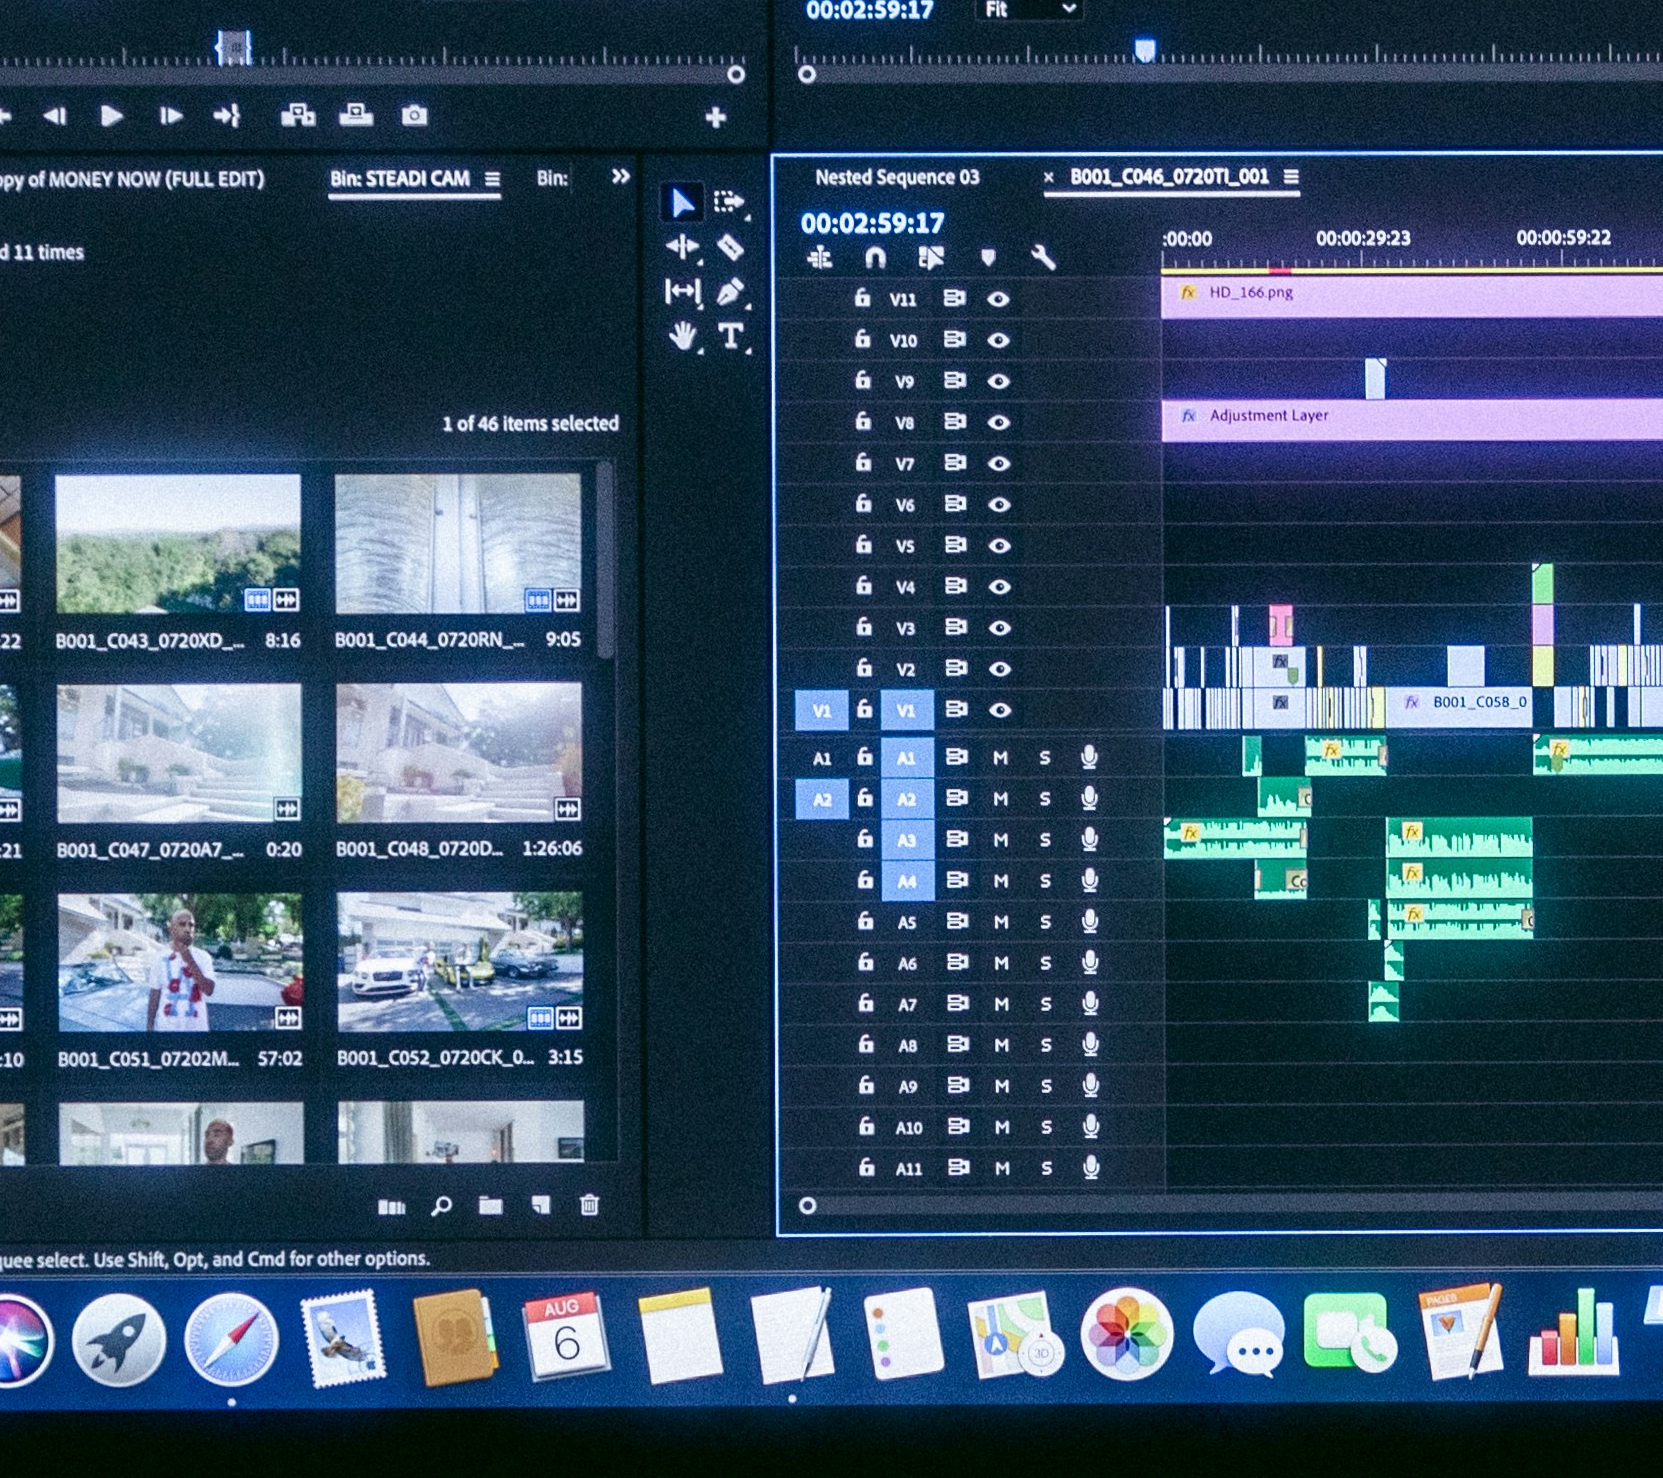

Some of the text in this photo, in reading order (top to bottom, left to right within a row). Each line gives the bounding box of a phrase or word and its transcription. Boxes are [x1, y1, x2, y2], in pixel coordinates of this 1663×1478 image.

[806, 0, 934, 20] 00:02:59:17
[986, 0, 1008, 18] Fit
[27, 170, 46, 188] of
[48, 170, 114, 188] MONEY
[117, 170, 162, 188] NOW
[164, 169, 215, 191] (FULL
[218, 169, 265, 190] EDIT)
[330, 169, 471, 188] Bin: STEADI CAM
[815, 167, 981, 189] Nested Sequence 03
[801, 212, 945, 234] 00:02:59:17
[1316, 229, 1412, 247] 00:00:29:23
[14, 244, 34, 261] 11
[37, 243, 85, 261] times
[889, 292, 917, 307] V11
[1209, 285, 1294, 302] HD_166.png
[443, 414, 620, 432] 1 of 46 items selected
[1210, 408, 1329, 425] Adjustment Layer
[895, 498, 916, 513] V6
[265, 632, 302, 649] 8:16
[523, 839, 583, 857] 1:26:06
[897, 874, 917, 889] A4
[257, 1050, 303, 1067] 57:02
[548, 1048, 584, 1066] 3:15
[895, 1162, 923, 1177] A11
[36, 1251, 89, 1269] select.
[93, 1252, 125, 1269] Use
[127, 1250, 169, 1270] Shift,
[173, 1251, 209, 1271] Opt,
[212, 1250, 244, 1268] and
[247, 1250, 286, 1267] Cmd
[289, 1249, 314, 1267] for
[316, 1250, 362, 1267] other
[364, 1250, 431, 1270] options.
[543, 1298, 579, 1317] AUG
[554, 1325, 581, 1361] 6
